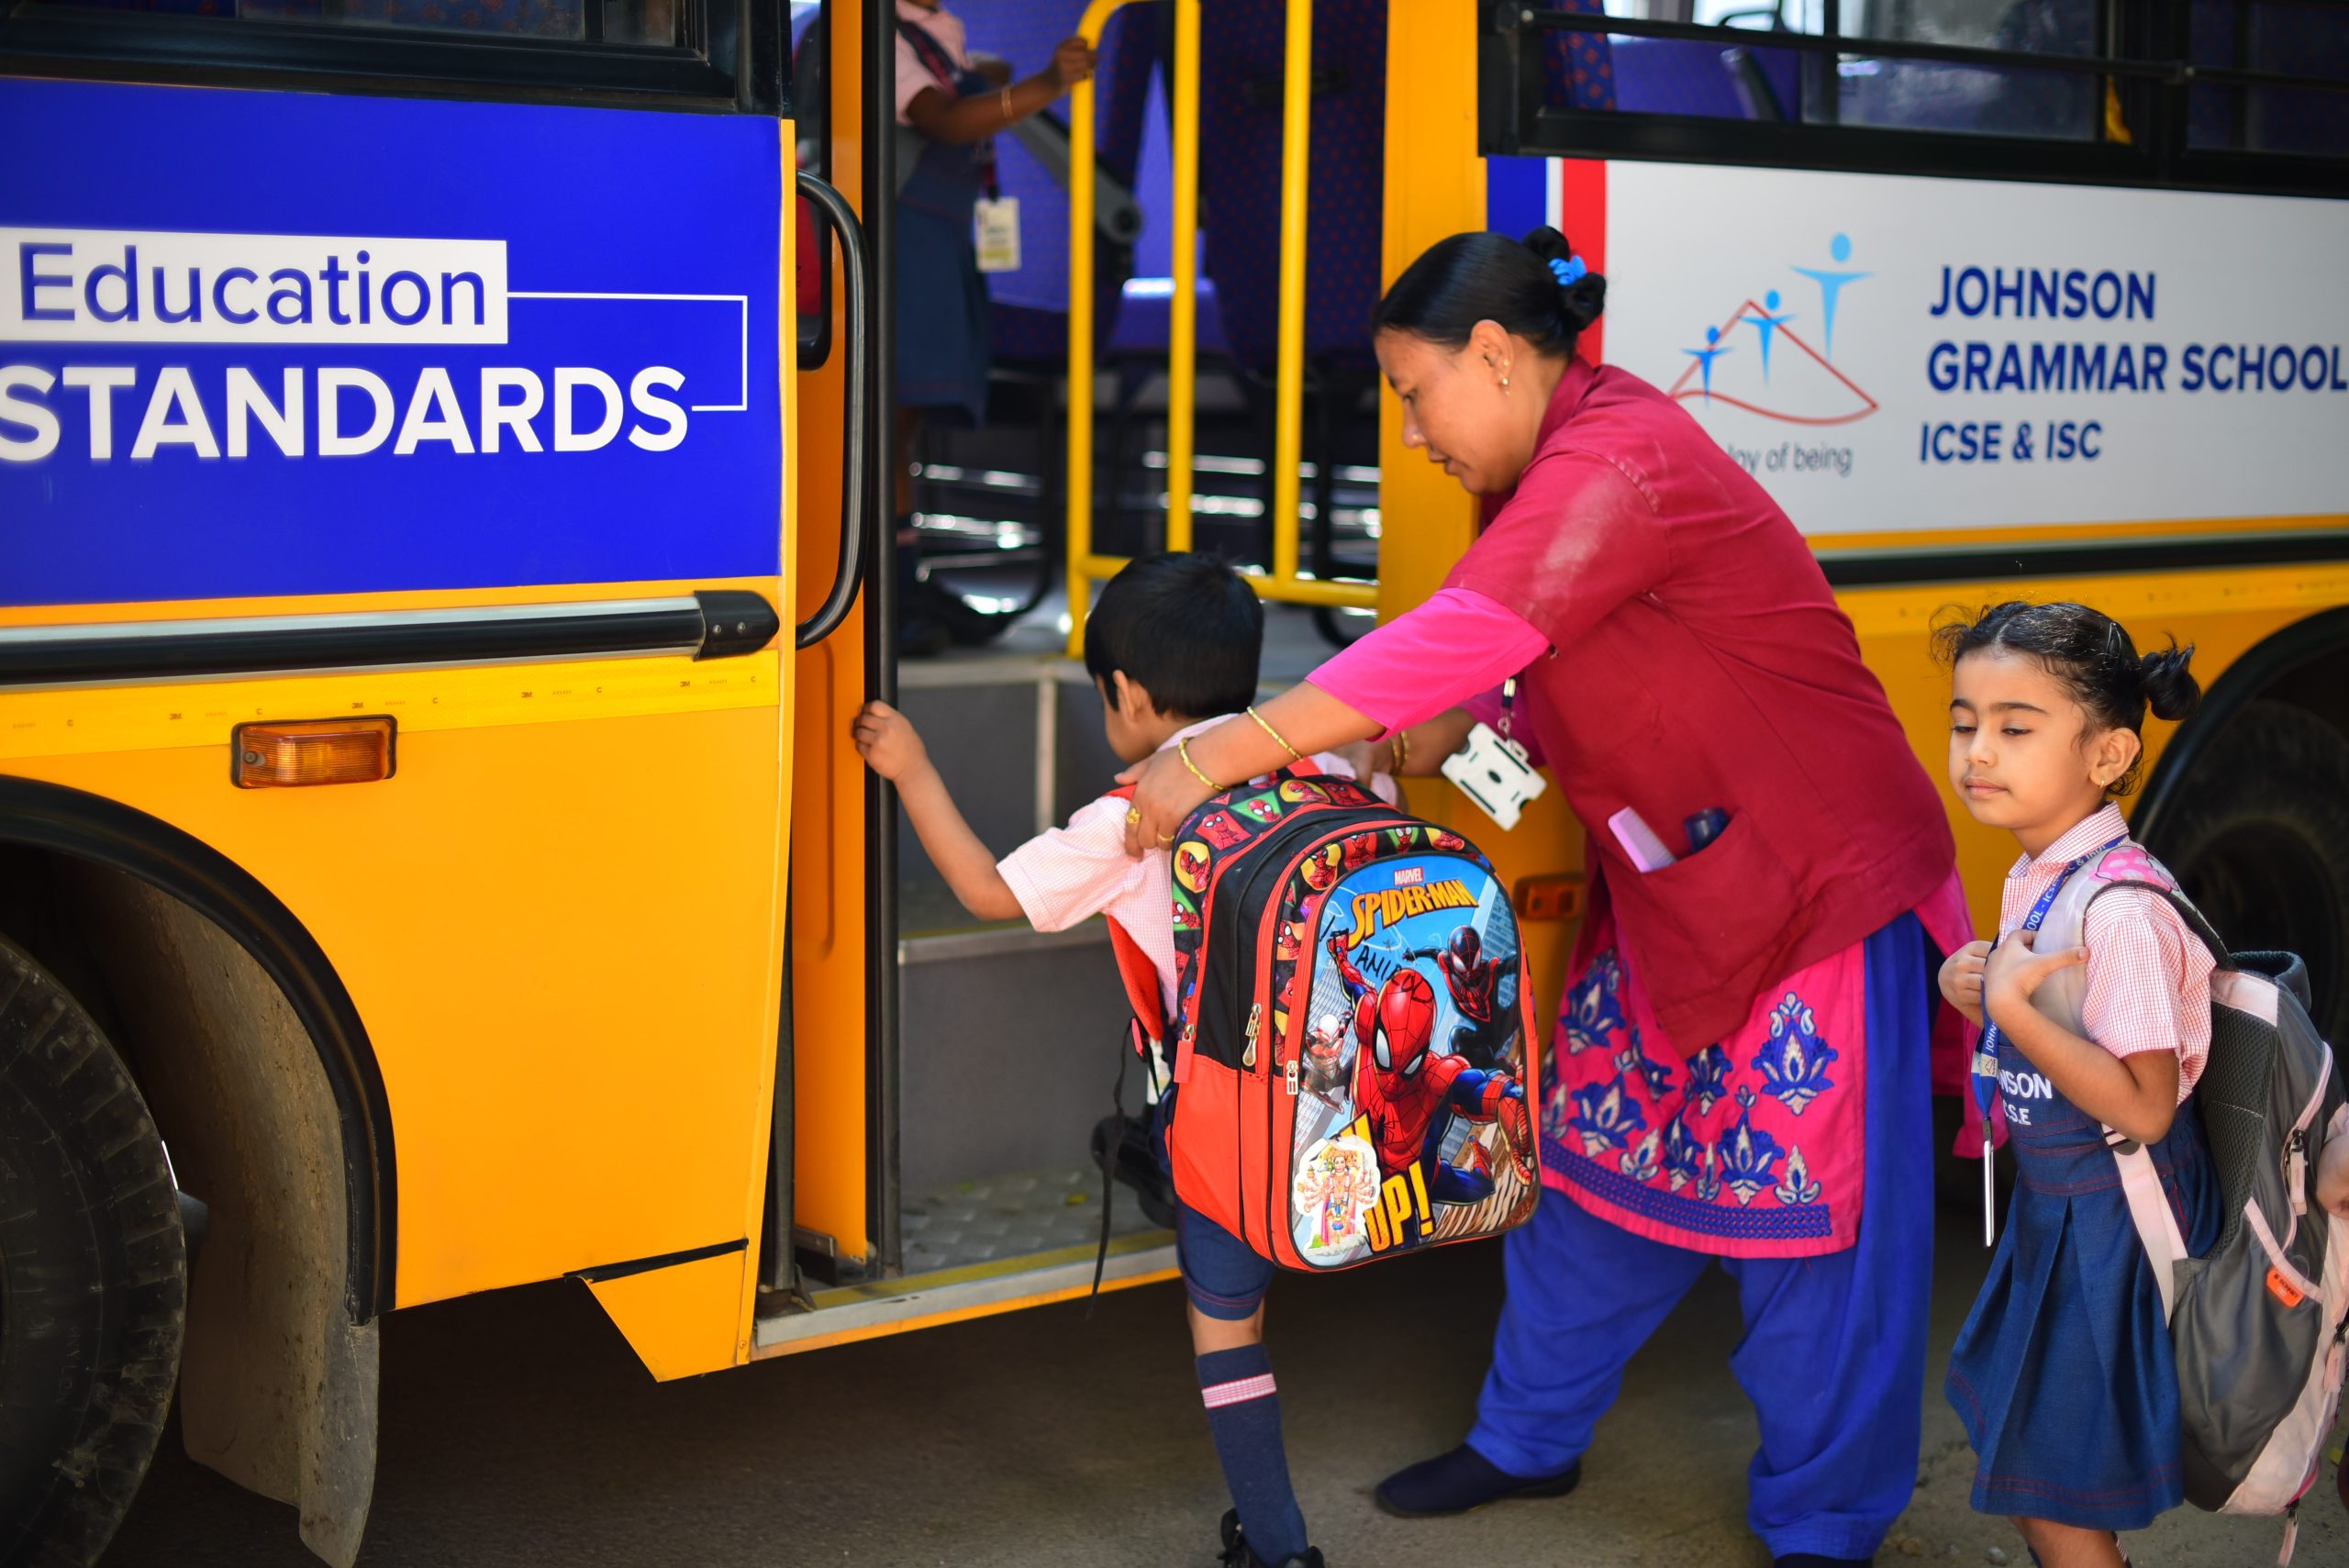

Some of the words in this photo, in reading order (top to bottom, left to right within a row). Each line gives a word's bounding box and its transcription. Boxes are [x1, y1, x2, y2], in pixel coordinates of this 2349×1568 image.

[19, 242, 486, 326] Education
[1929, 265, 2156, 320] JOHNSON
[1928, 340, 2168, 393] GRAMMAR
[2180, 342, 2348, 393] SCHOOL
[0, 364, 688, 462] STANDARDS
[1765, 440, 1789, 473] of
[1794, 440, 1854, 478] being
[1920, 421, 2003, 462] ICSE
[2012, 421, 2034, 462] &
[2046, 420, 2103, 461] ISC
[1394, 867, 1422, 886] MARVEL
[1985, 1022, 1998, 1053] JOHN
